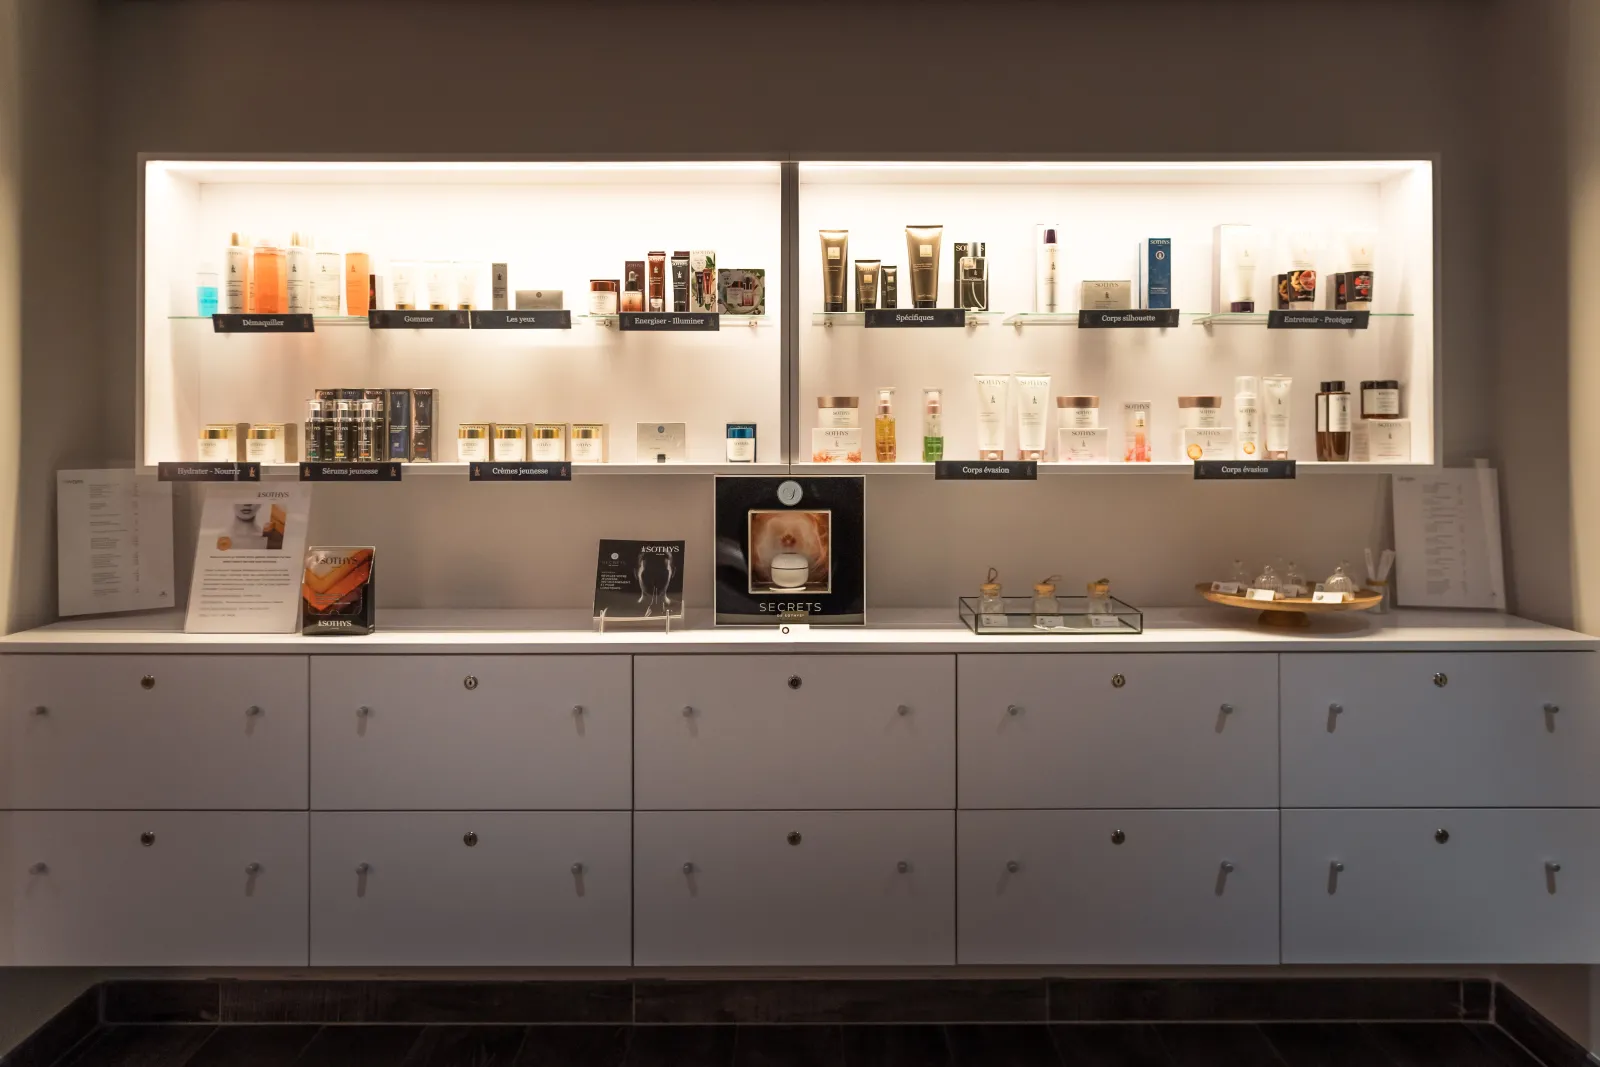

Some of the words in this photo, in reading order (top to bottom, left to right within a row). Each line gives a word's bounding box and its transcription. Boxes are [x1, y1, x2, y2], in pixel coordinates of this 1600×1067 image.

[404, 315, 434, 323] Gommer
[506, 315, 518, 323] Les
[519, 317, 535, 325] yeux
[634, 317, 667, 326] Energiser
[672, 317, 704, 325] Illuminer
[895, 314, 934, 322] Spécifiques
[1101, 314, 1121, 323] Corps
[1122, 314, 1156, 322] silhouette
[1324, 316, 1353, 325] Protéger
[242, 319, 284, 327] Démaquiller
[177, 467, 208, 476] Hydrater
[322, 467, 348, 475] Sérums
[348, 468, 379, 476] jeunesse
[492, 467, 518, 475] Crèmes
[518, 468, 549, 476] jeunesse
[962, 466, 983, 475] Corps
[983, 466, 1010, 474] évasion
[1221, 466, 1242, 475] Corps
[646, 545, 680, 553] SOTHYS
[320, 556, 358, 565] SOTHYS
[759, 602, 822, 612] SECRETS
[322, 619, 352, 627] SOTHYS
